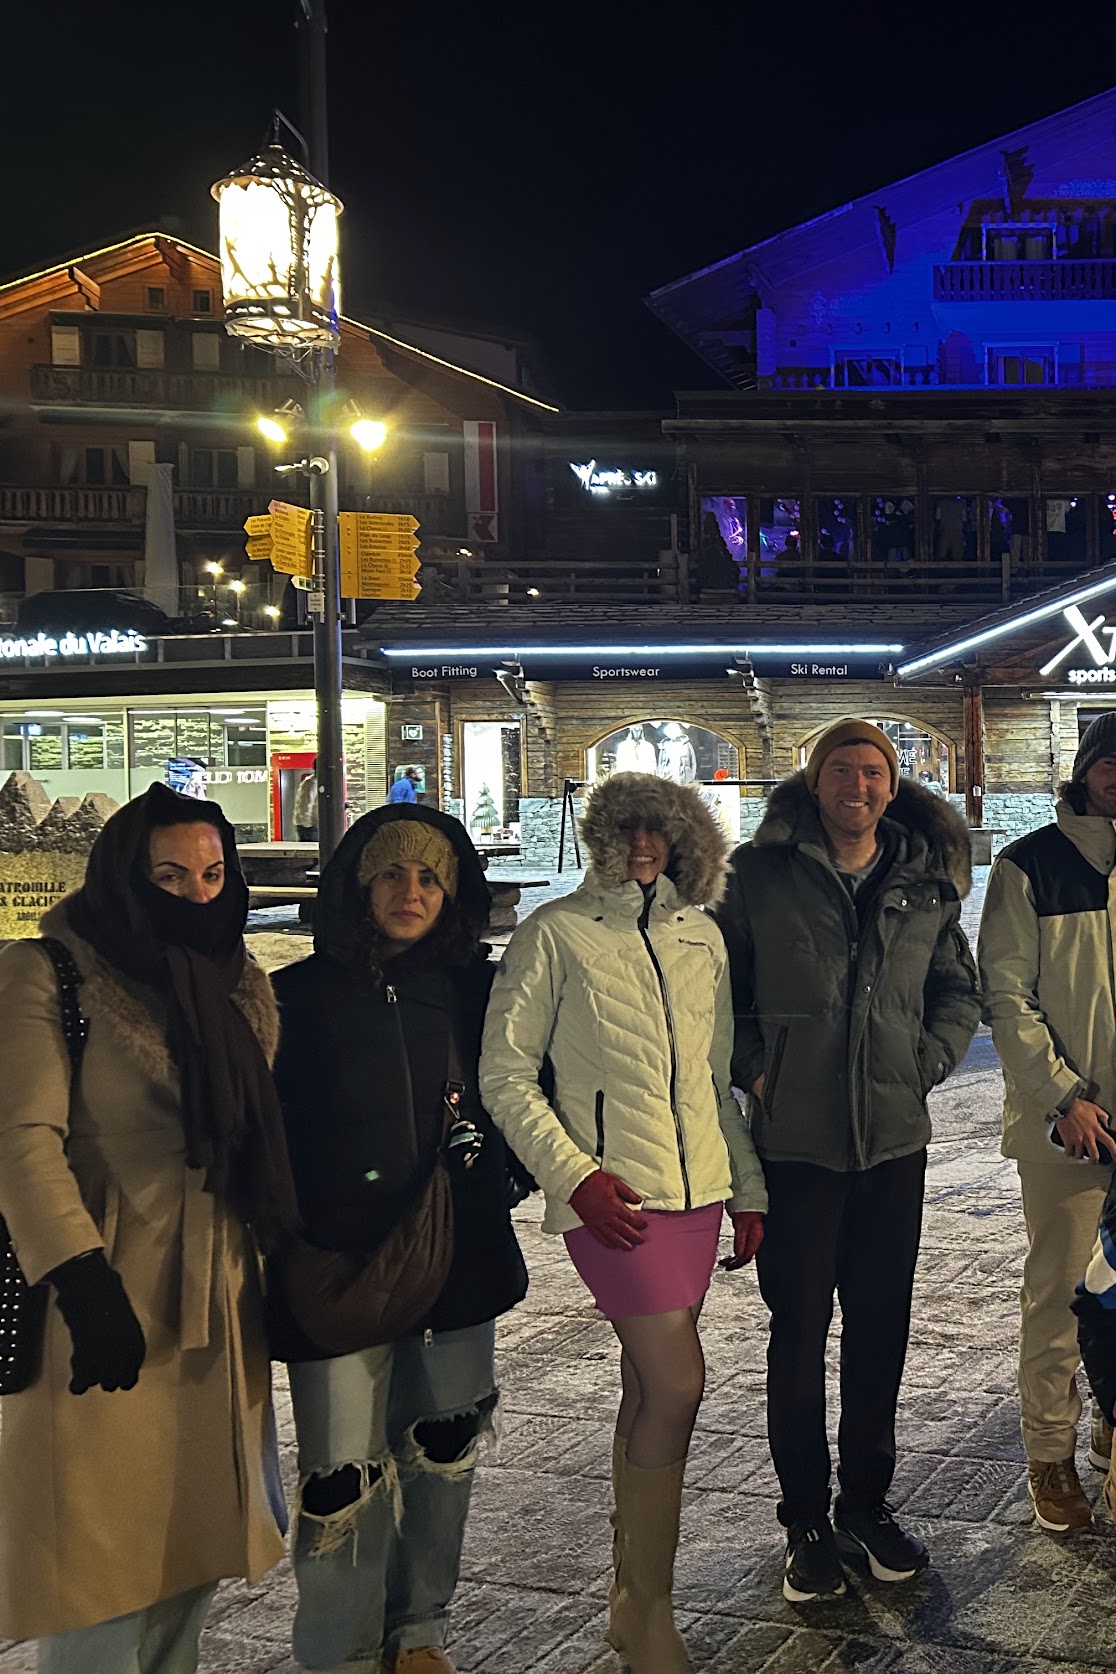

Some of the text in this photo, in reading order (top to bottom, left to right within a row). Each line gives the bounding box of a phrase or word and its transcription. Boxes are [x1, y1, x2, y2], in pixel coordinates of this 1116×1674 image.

[60, 632, 88, 656] du
[86, 629, 147, 654] Valais
[411, 665, 477, 678] Boot Fitting
[592, 666, 660, 680] Sportswear
[790, 663, 848, 676] Ski Rental
[1068, 667, 1116, 685] sports
[13, 896, 61, 907] GLACIE
